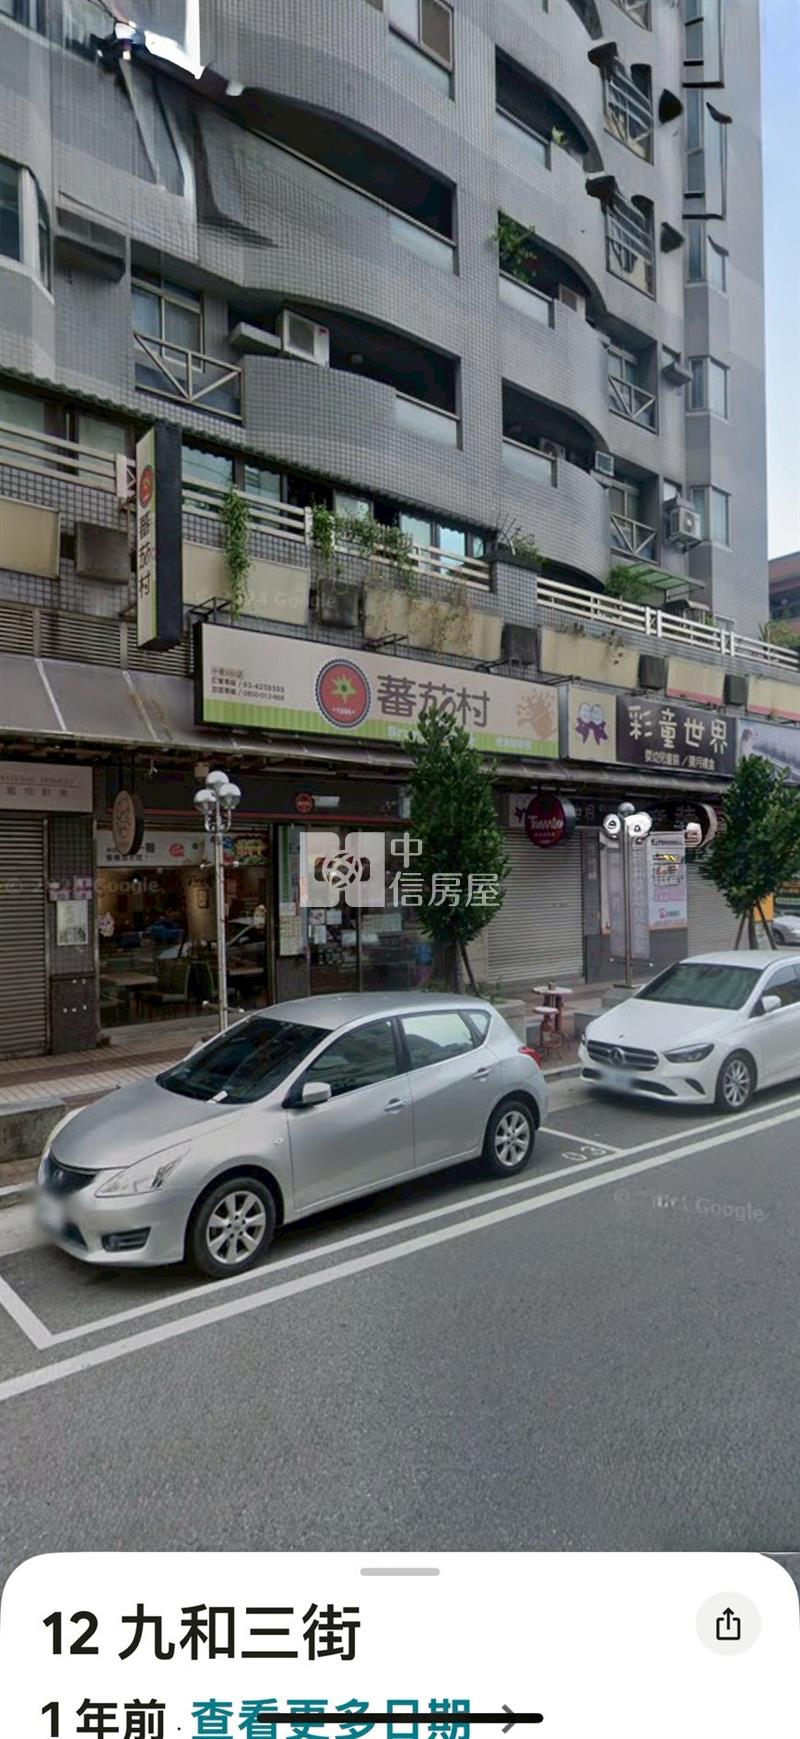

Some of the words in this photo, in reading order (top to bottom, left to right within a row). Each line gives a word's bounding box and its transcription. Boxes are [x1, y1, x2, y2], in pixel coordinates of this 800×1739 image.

[138, 510, 151, 599] 蕃茄村
[377, 674, 490, 728] 蕃茄村
[628, 705, 728, 755] 彩童世界
